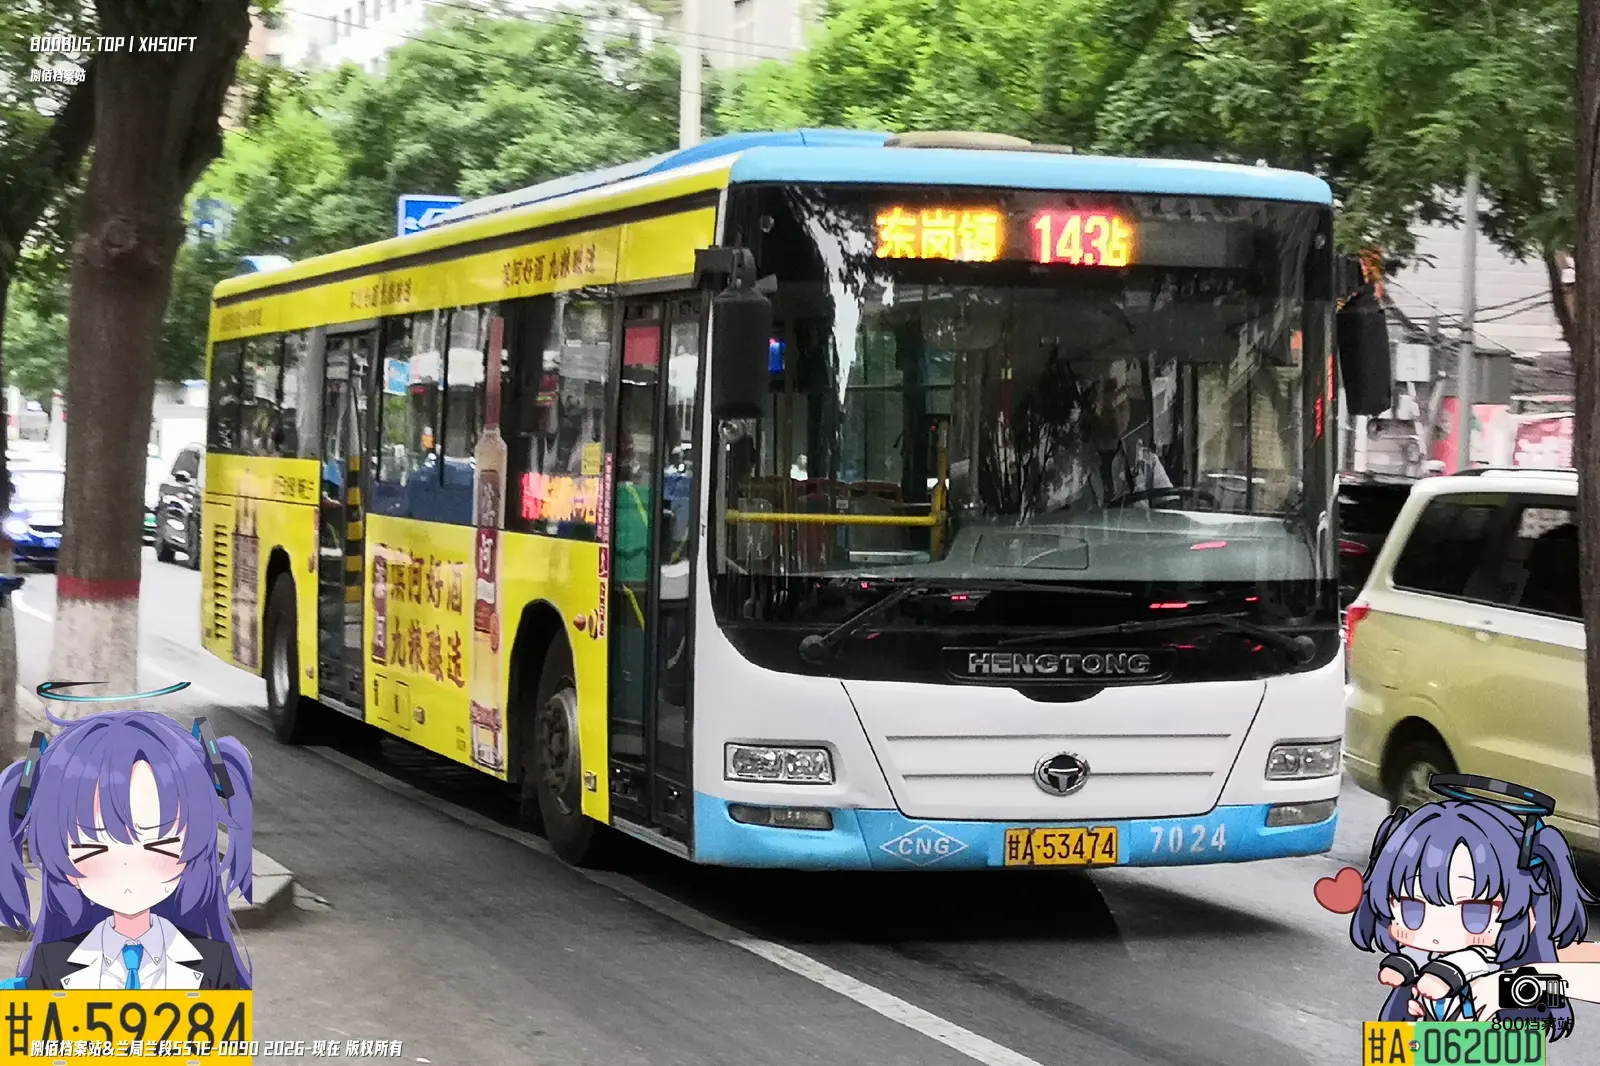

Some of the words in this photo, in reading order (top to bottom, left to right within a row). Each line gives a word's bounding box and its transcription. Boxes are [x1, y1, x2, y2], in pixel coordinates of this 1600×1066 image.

[876, 207, 998, 262] 东岗镇
[968, 652, 1151, 675] HENGTONG
[899, 836, 950, 856] CNG
[1150, 823, 1228, 852] 7024
